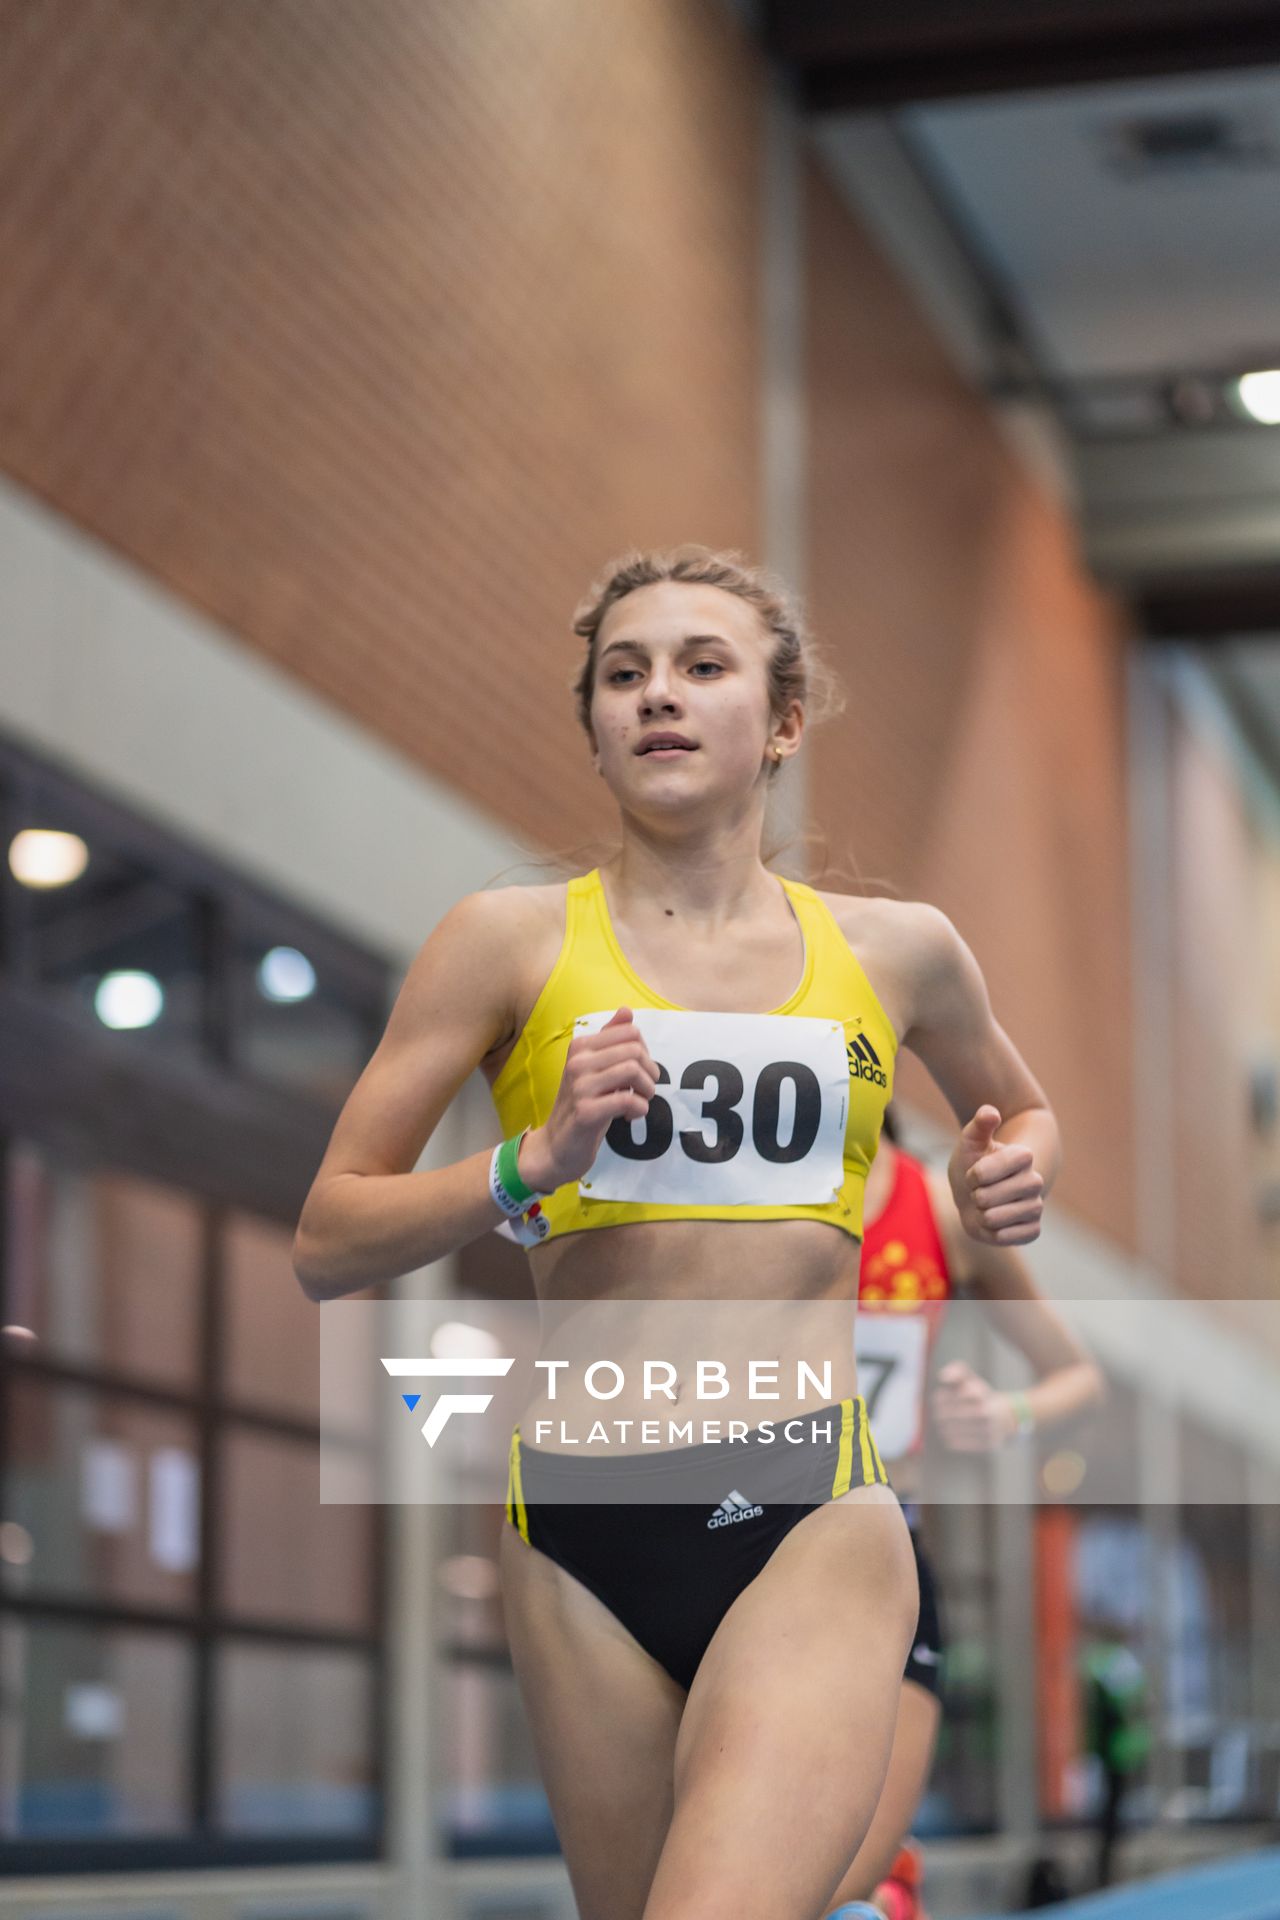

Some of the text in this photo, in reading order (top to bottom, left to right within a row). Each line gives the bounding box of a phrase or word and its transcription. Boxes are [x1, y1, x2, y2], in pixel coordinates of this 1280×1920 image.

[847, 1058, 887, 1088] didas
[604, 1060, 823, 1164] 630
[707, 1505, 764, 1530] adidas
